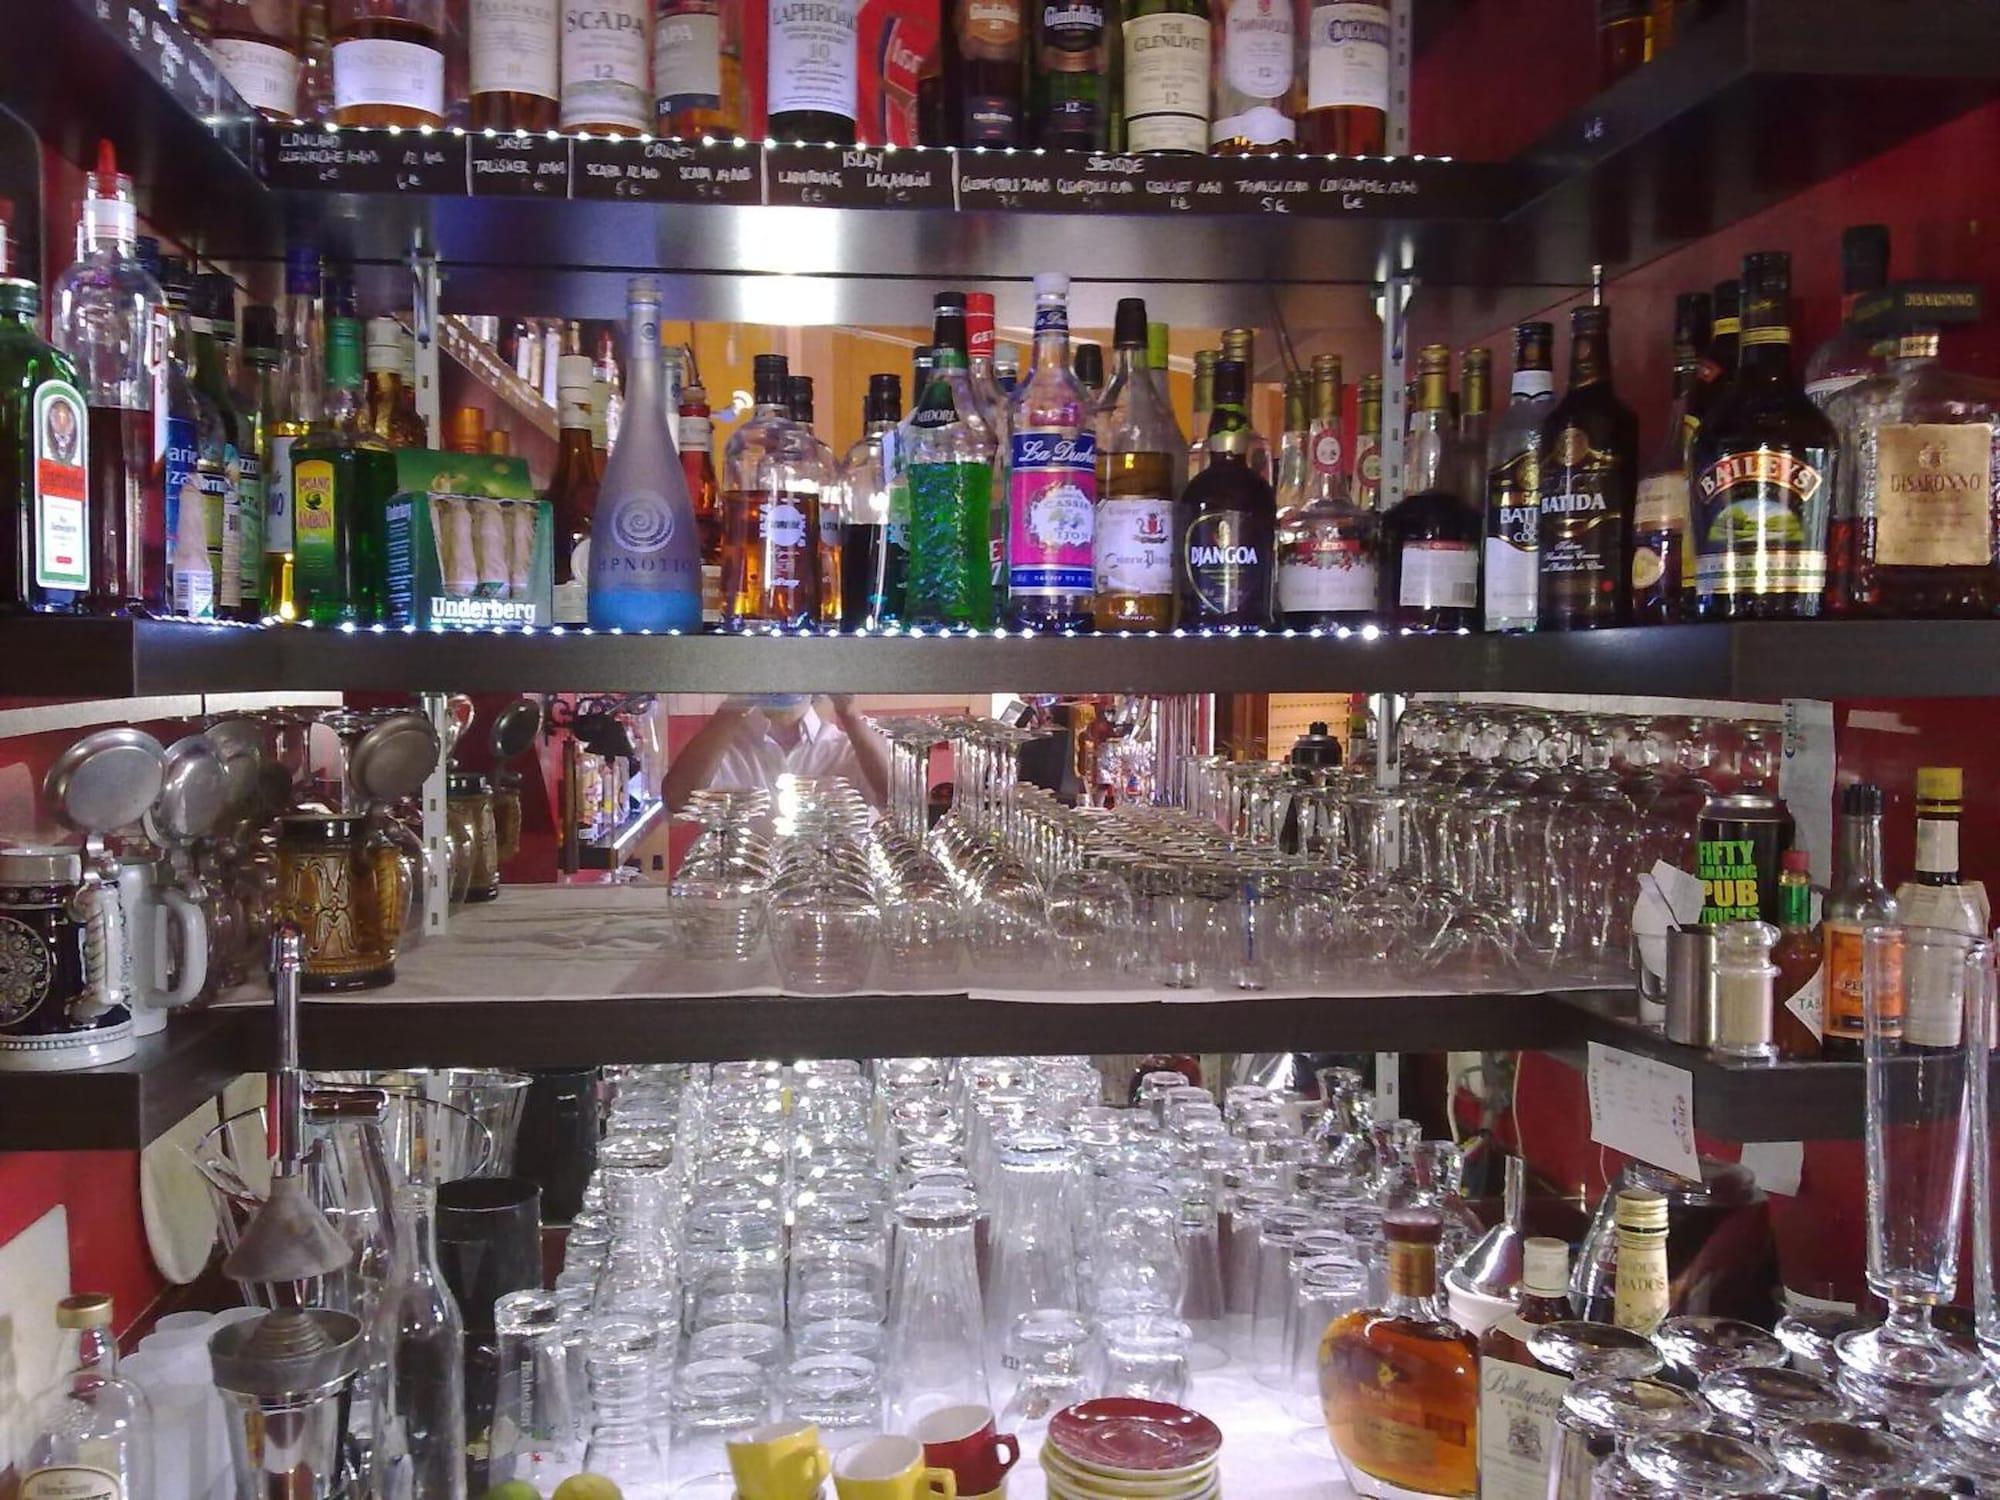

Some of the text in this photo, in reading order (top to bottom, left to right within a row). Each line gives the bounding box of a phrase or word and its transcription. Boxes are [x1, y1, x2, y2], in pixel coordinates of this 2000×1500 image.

[843, 152, 884, 171] ISLAY
[1700, 456, 1812, 497] BAILEYS
[1890, 472, 1980, 495] DISARONNO
[1541, 492, 1606, 515] BATIDA
[1500, 508, 1538, 524] BATI
[1191, 547, 1258, 567] DJANGOA
[431, 597, 537, 624] Underberg
[1699, 841, 1755, 865] FIFTY
[1702, 880, 1759, 906] PUB
